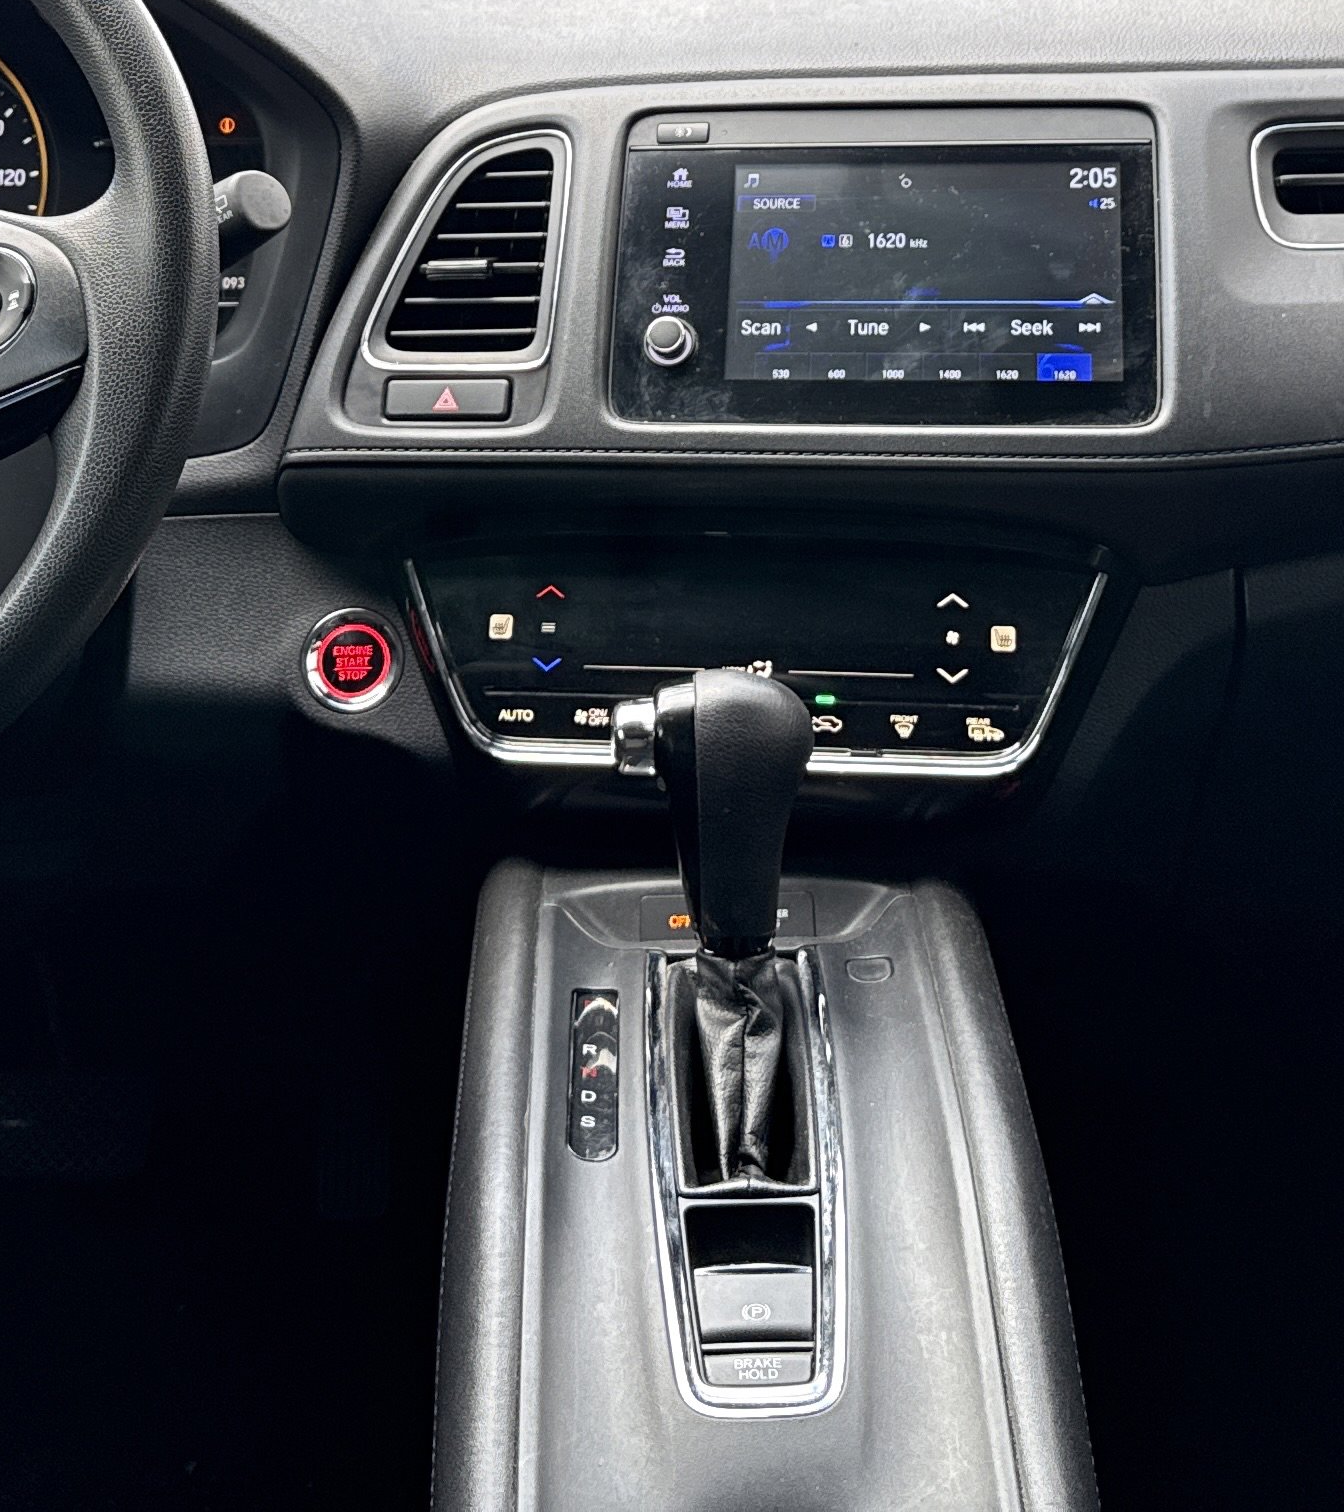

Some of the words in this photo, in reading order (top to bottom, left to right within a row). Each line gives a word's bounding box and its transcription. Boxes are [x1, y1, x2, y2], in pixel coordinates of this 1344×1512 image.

[667, 178, 693, 189] HOME
[1069, 166, 1117, 189] 2:05
[753, 197, 801, 210] SOURCE
[1099, 197, 1117, 209] 25
[664, 220, 690, 230] MENU
[868, 232, 907, 249] 1620
[909, 238, 928, 249] kHz
[662, 257, 686, 268] BACK
[663, 293, 683, 304] VOL
[661, 304, 690, 314] AUDIO
[740, 319, 782, 336] Scan
[847, 319, 890, 336] Tune
[1010, 319, 1054, 336] Seek
[995, 368, 1019, 380] 1620
[1053, 369, 1077, 381] 1620
[332, 644, 374, 657] ENGINE
[335, 656, 371, 668] START
[338, 670, 368, 681] STOP
[498, 708, 535, 723] AUTO
[588, 716, 610, 727] OFF
[889, 714, 919, 724] FRONT
[965, 717, 991, 726] REAR
[582, 1043, 598, 1056] R
[580, 1089, 597, 1103] D
[580, 1114, 596, 1128] S
[733, 1357, 783, 1370] BRAKE
[738, 1368, 779, 1381] HOLD
